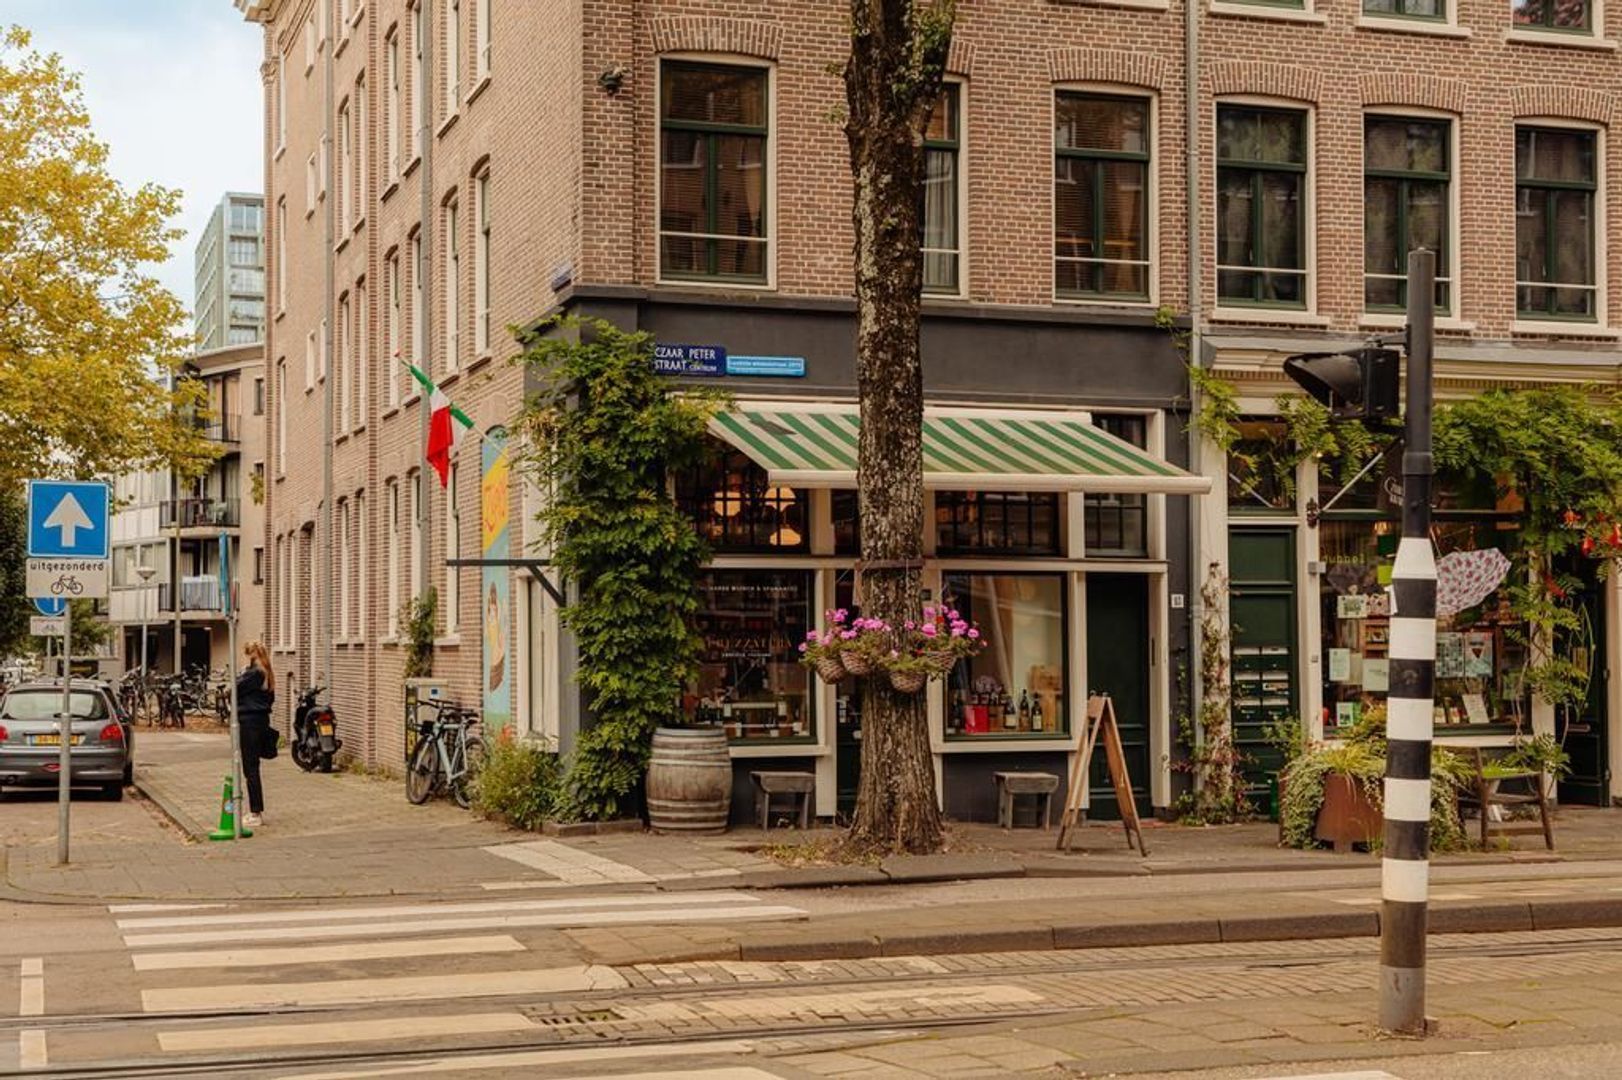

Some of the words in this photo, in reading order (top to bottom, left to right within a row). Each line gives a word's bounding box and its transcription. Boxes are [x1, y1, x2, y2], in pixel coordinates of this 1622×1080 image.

[655, 347, 684, 358] CZAAR
[689, 348, 716, 359] PETER
[654, 360, 687, 371] STRAAT
[30, 561, 104, 573] uitgezonderd
